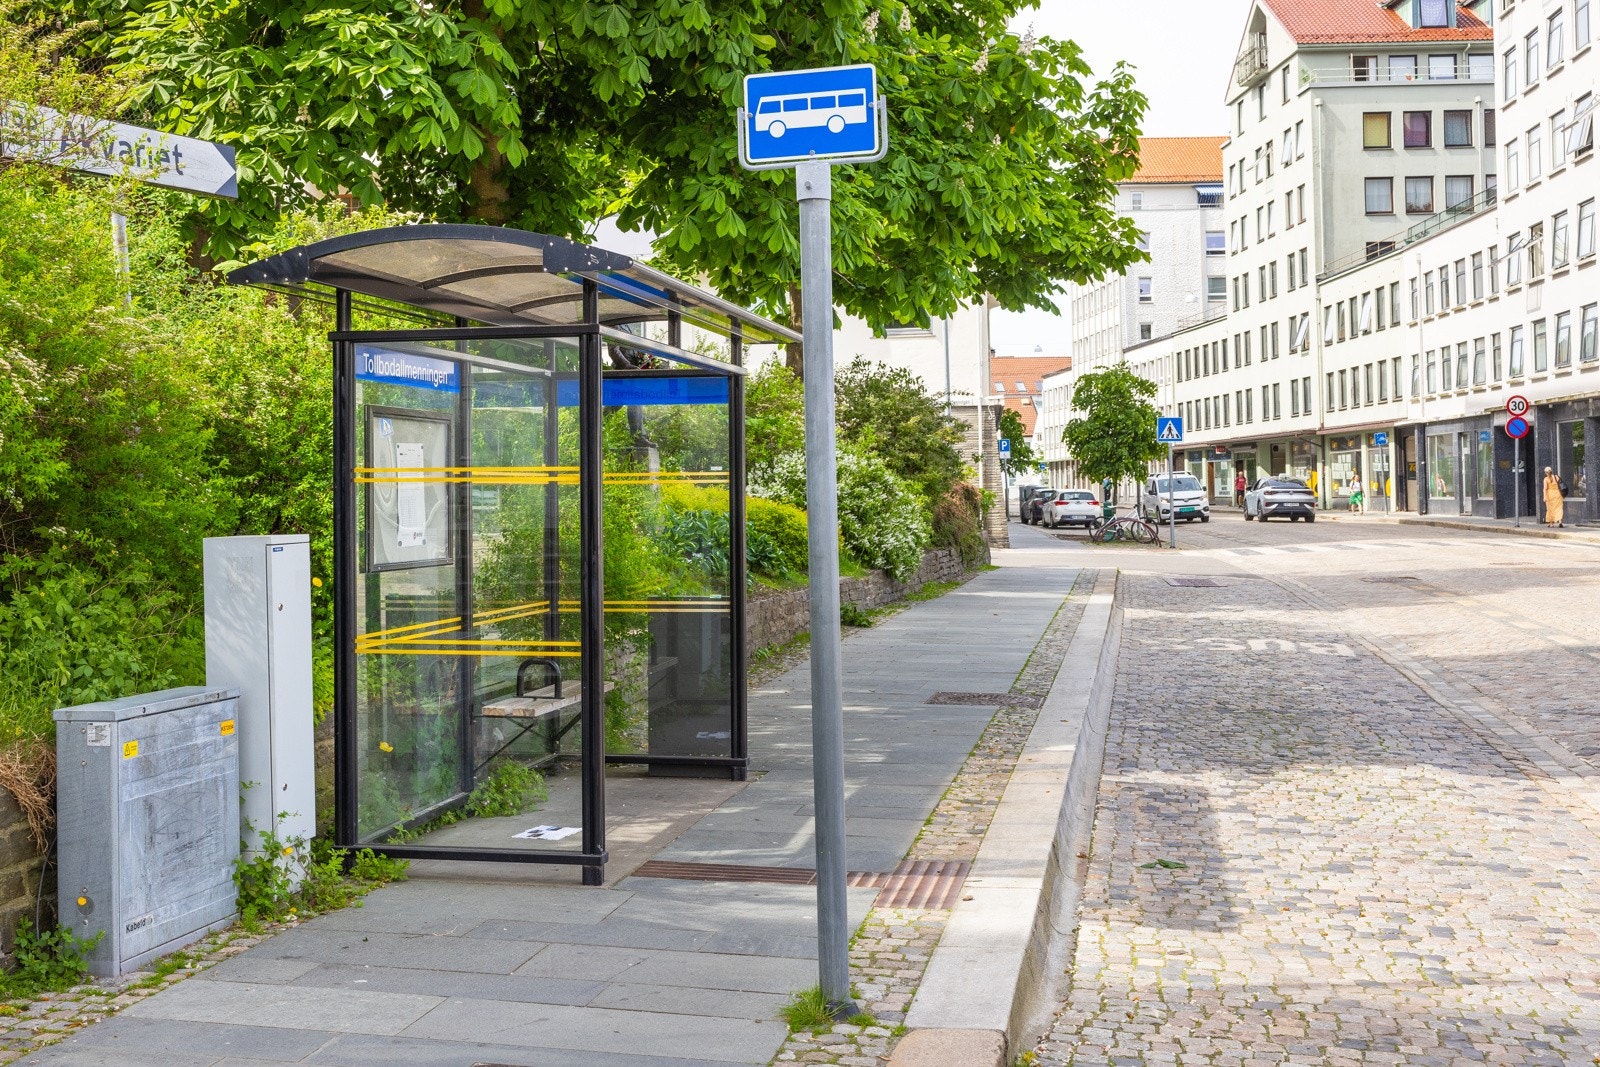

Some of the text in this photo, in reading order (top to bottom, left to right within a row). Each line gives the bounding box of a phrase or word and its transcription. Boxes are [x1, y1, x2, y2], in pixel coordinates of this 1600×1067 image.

[363, 353, 448, 387] Tollbodallmenningen
[1511, 401, 1525, 411] 30
[1001, 440, 1008, 451] P
[125, 917, 153, 934] Kabeld
